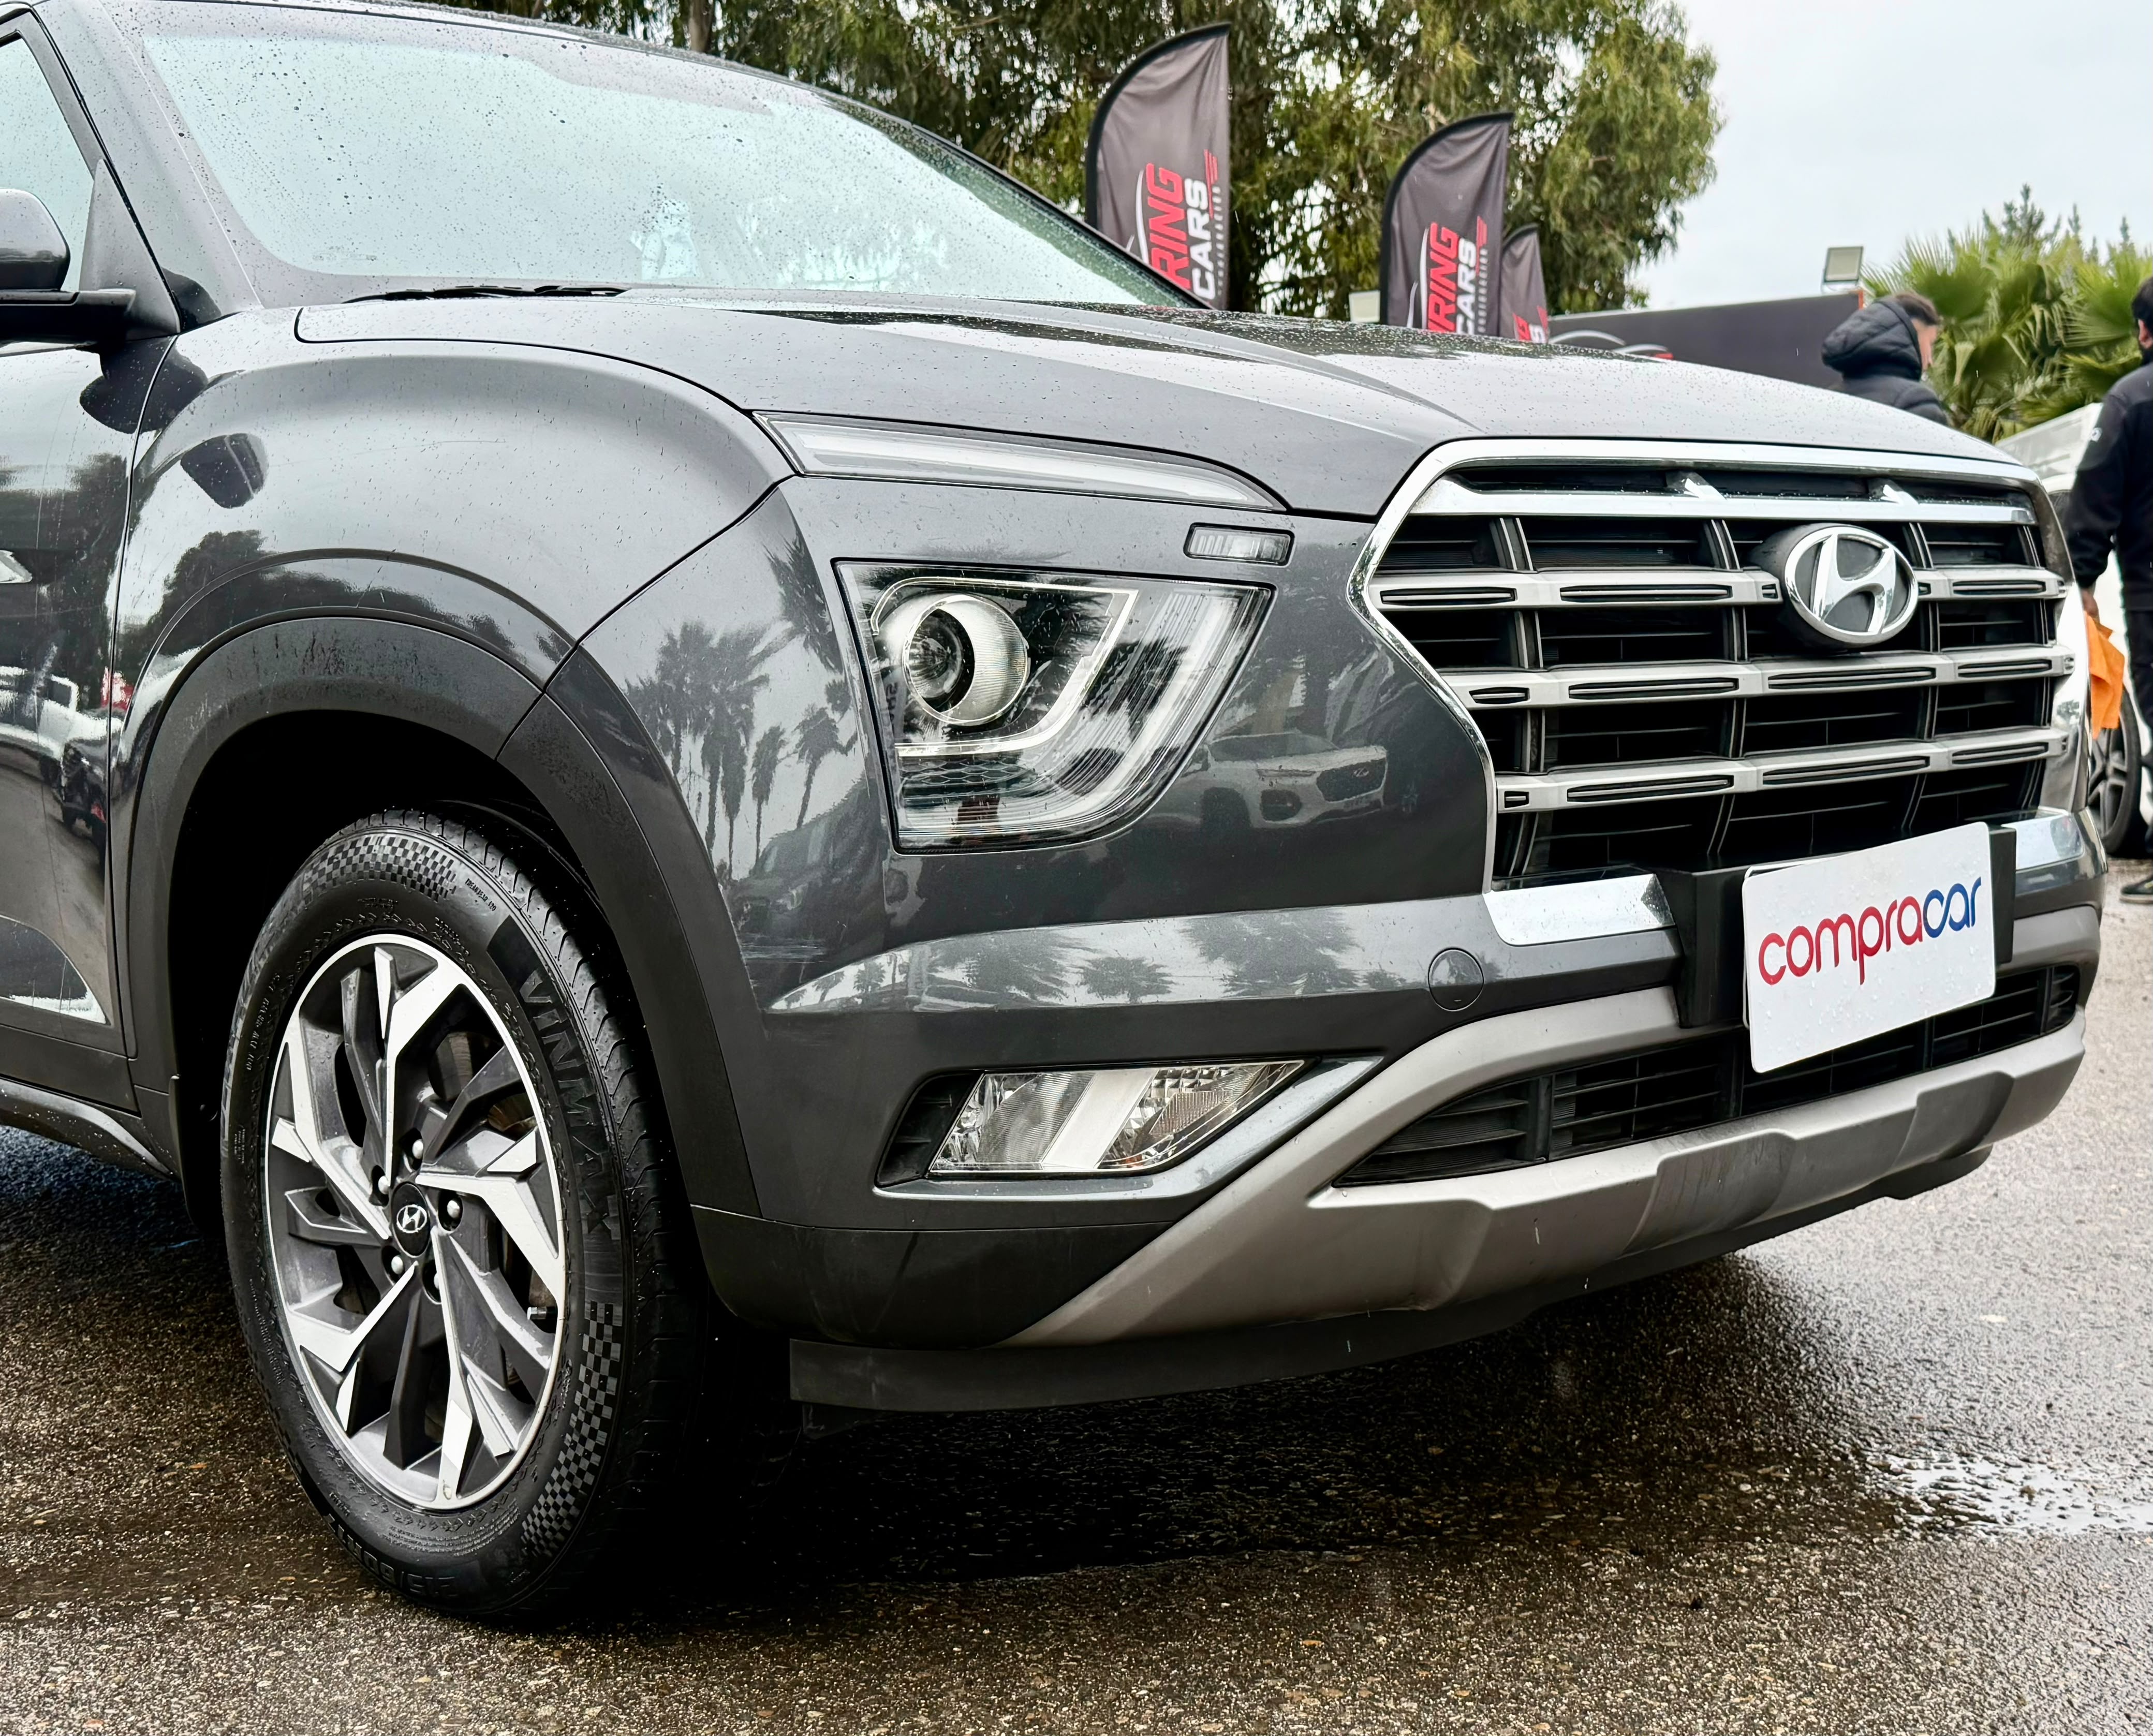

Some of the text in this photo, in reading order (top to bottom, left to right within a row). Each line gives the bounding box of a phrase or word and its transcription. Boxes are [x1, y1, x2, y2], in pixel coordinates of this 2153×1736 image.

[1185, 178, 1215, 300] CARS
[1456, 237, 1476, 335] CARS
[1758, 877, 1982, 985] compracar
